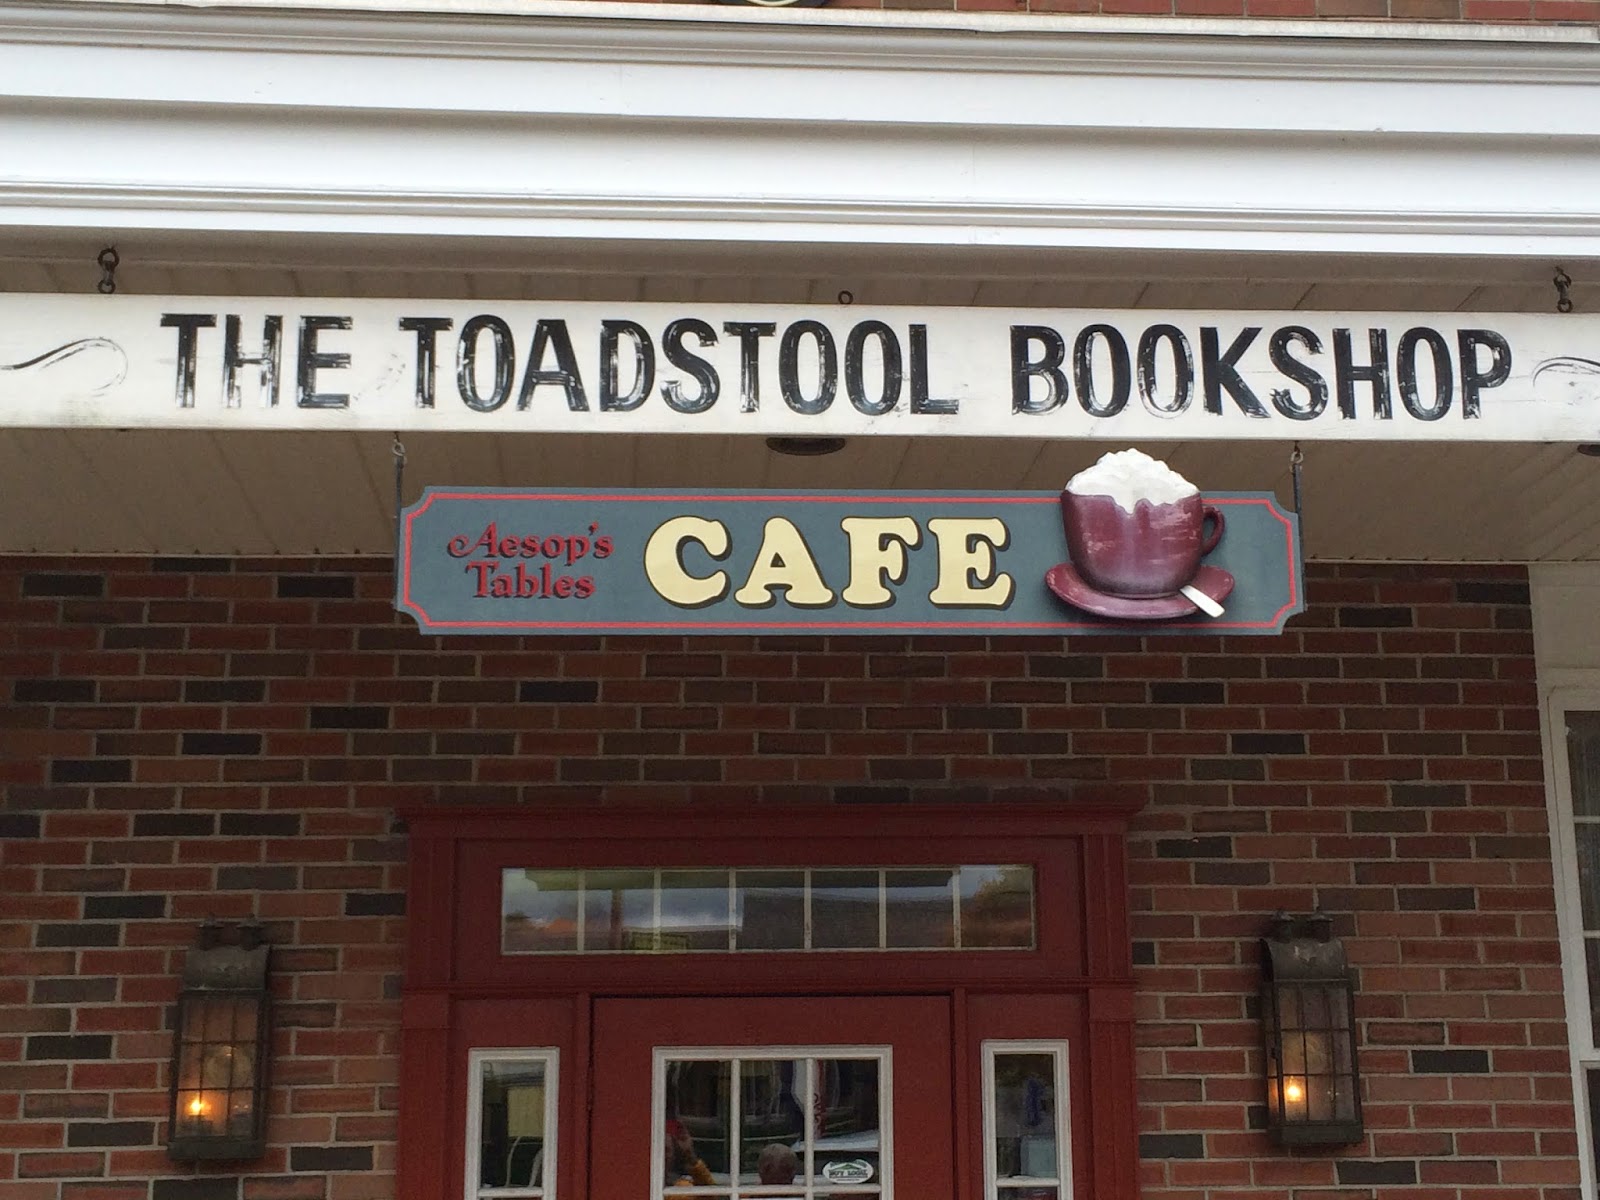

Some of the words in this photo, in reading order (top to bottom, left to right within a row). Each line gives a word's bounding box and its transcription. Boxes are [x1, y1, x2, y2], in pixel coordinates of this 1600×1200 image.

[160, 313, 353, 410] THE
[398, 314, 960, 415] TOADSTOOL
[1010, 323, 1512, 420] BOOKSHOP
[447, 521, 614, 565] Aesop's
[644, 515, 1013, 610] CAFE
[466, 560, 596, 600] Tables
